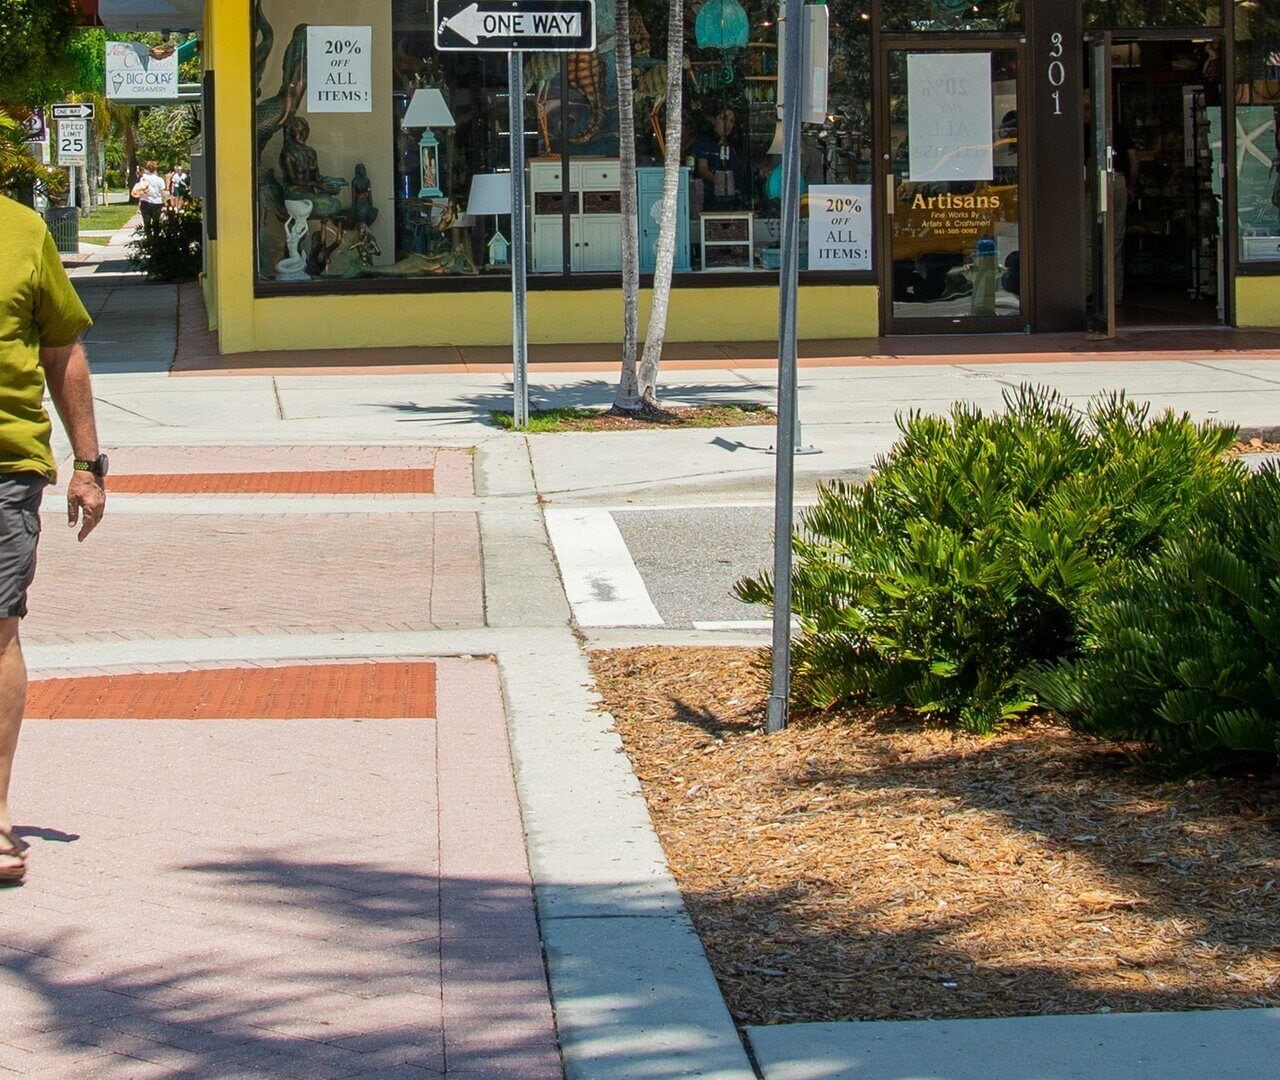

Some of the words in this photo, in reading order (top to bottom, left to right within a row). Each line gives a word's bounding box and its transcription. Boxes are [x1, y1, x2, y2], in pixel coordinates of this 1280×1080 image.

[483, 14, 525, 34] ONE
[533, 14, 576, 34] WAY
[324, 39, 362, 55] 20%
[330, 59, 351, 67] OFF
[126, 72, 144, 85] BIG
[145, 72, 173, 85] OLAF
[324, 72, 357, 85] ALL
[61, 138, 83, 152] 25
[825, 198, 862, 213] 20%
[911, 192, 1001, 210] Artisans
[831, 217, 851, 226] OFF
[921, 220, 942, 228] Artists
[954, 220, 991, 228] Craftsmen
[825, 230, 857, 243] ALL
